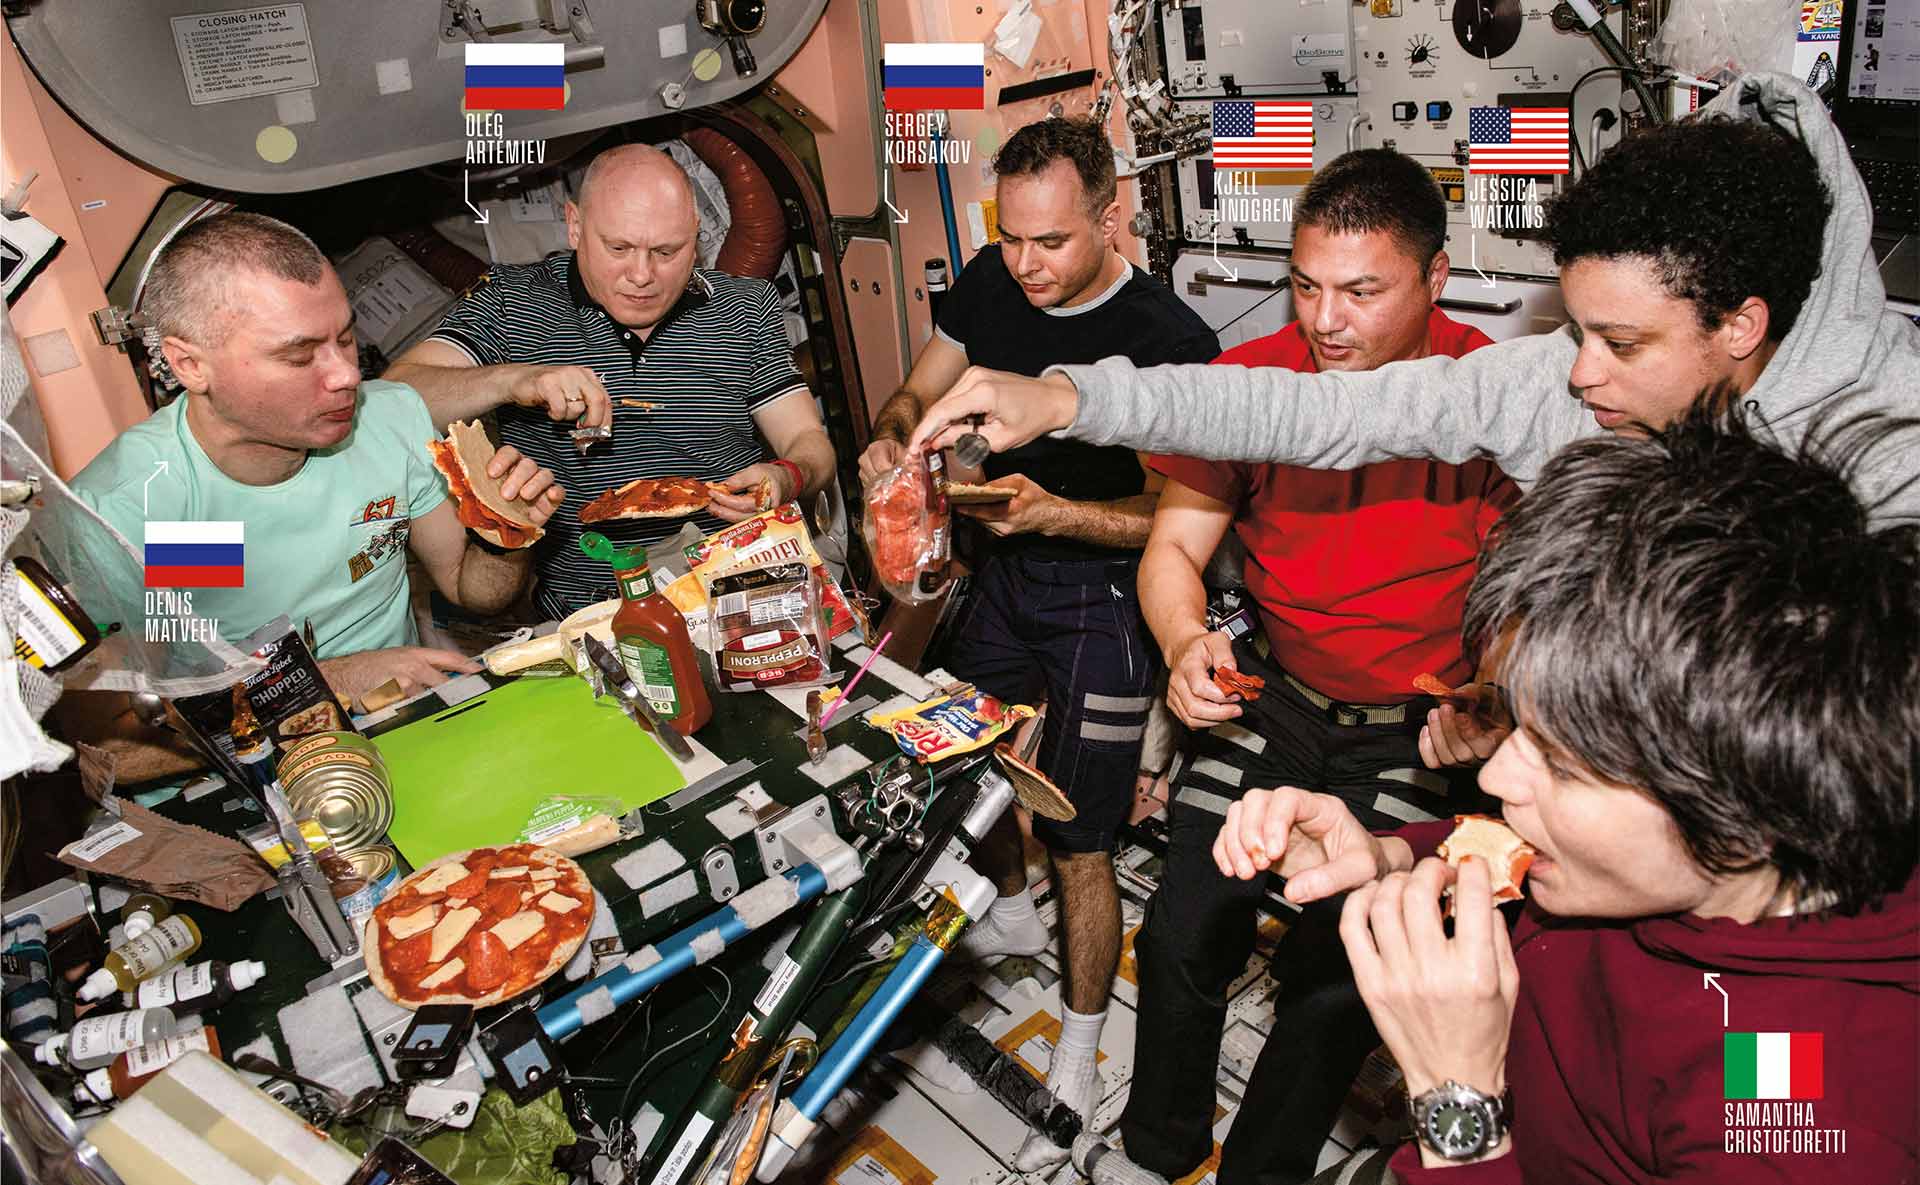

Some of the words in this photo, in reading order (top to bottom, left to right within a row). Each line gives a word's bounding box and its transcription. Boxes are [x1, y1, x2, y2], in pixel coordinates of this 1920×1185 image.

[199, 14, 247, 28] CLOSING
[249, 9, 286, 21] HATCH
[363, 496, 396, 523] 67
[687, 617, 709, 629] GLAC
[731, 645, 803, 667] PEPPERONI
[243, 668, 272, 689] Black
[268, 654, 295, 675] Label
[249, 666, 309, 709] CHOPPED
[288, 675, 314, 693] BACON
[301, 752, 357, 769] ЯБЛОК
[775, 979, 788, 994] Table
